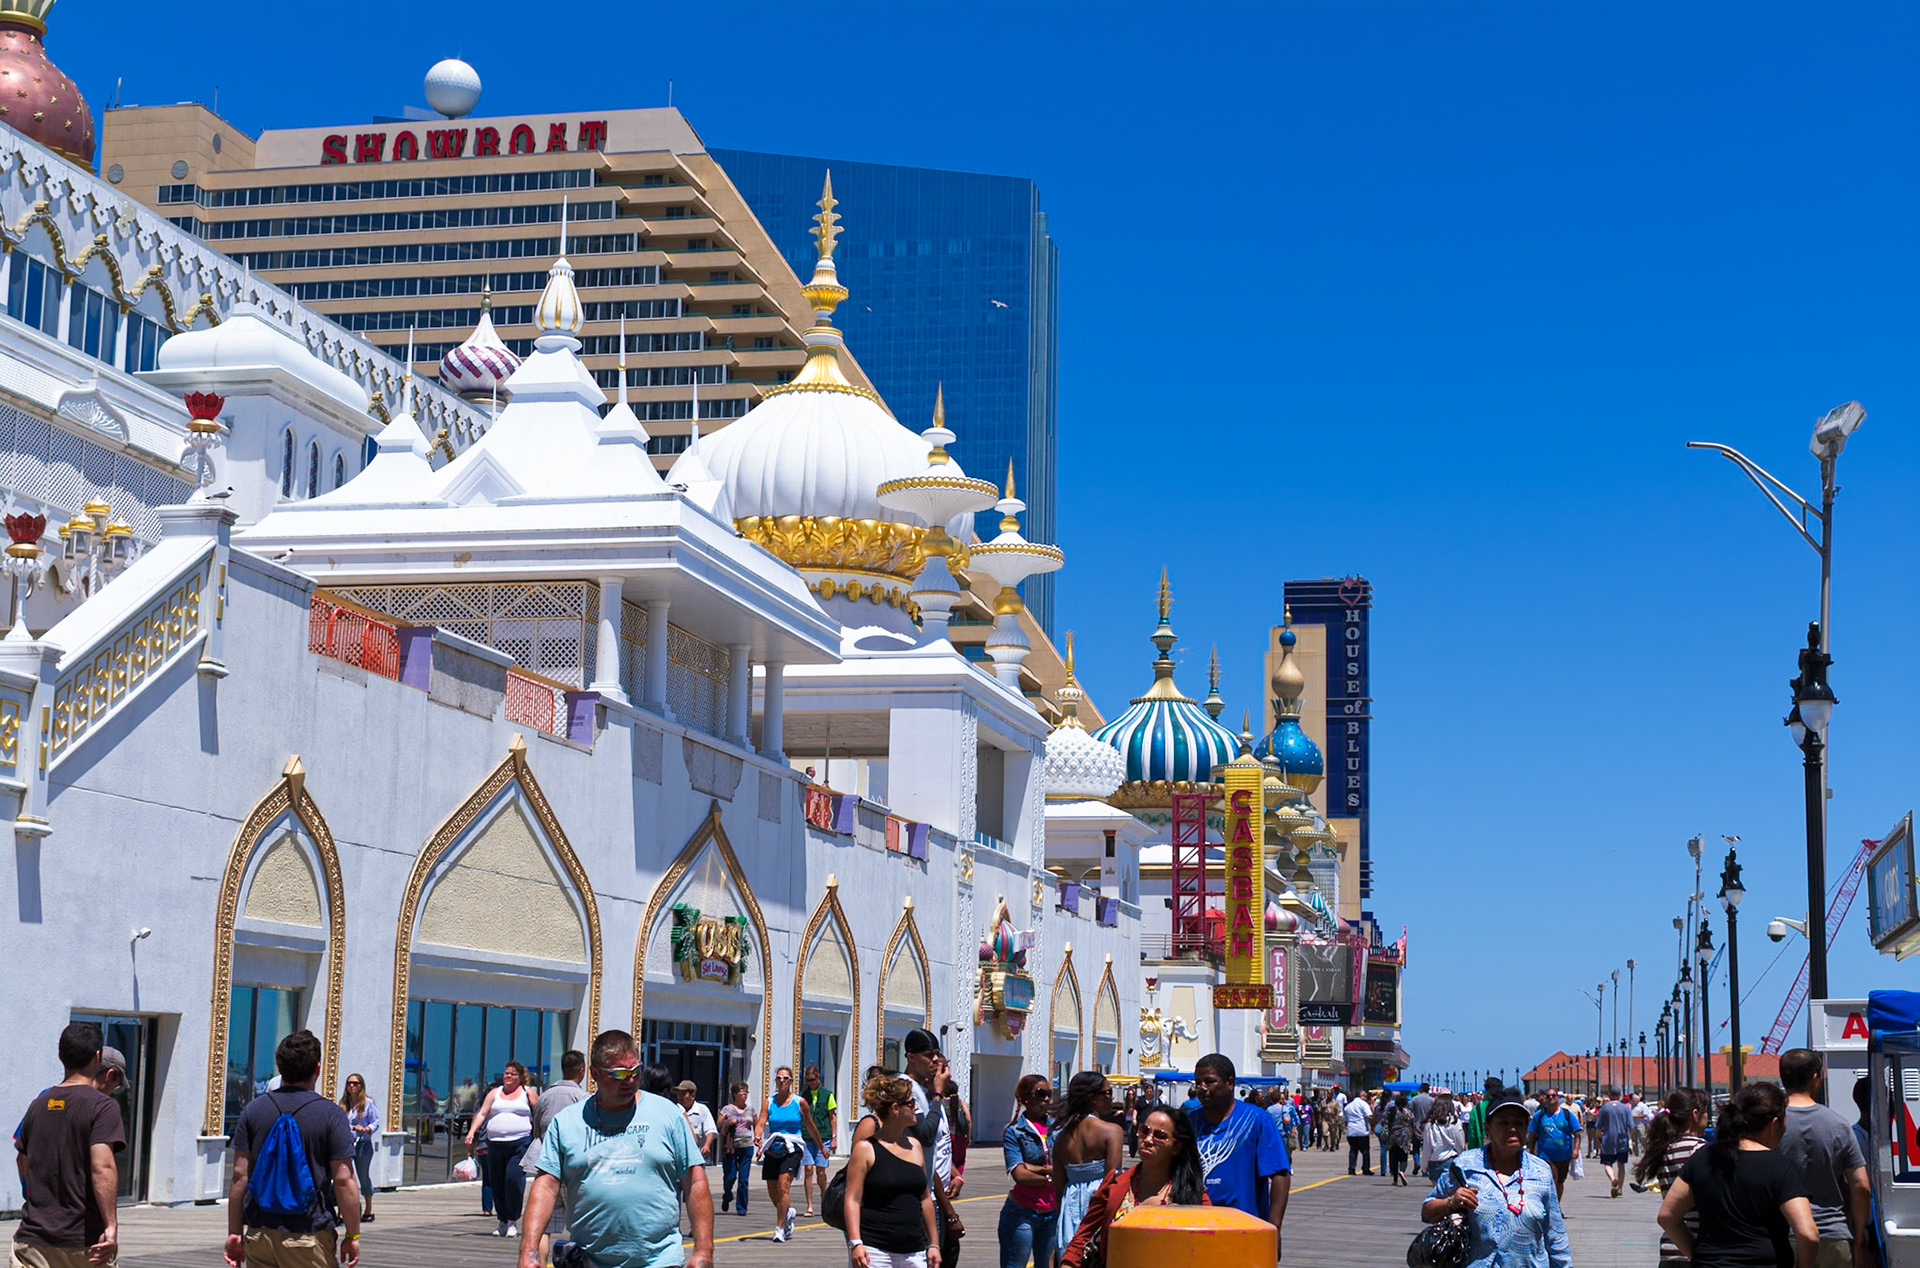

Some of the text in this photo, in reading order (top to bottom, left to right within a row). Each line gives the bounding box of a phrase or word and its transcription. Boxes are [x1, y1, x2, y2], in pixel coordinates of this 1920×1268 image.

[322, 120, 608, 165] SHOWBOAT
[1346, 609, 1361, 693] HOUSE
[1344, 701, 1362, 715] of
[1346, 721, 1361, 807] BLUES
[1230, 789, 1255, 958] CASBAH
[1216, 988, 1269, 1005] CAFE
[1273, 951, 1286, 1022] TRUMP
[626, 1124, 650, 1135] CAMP
